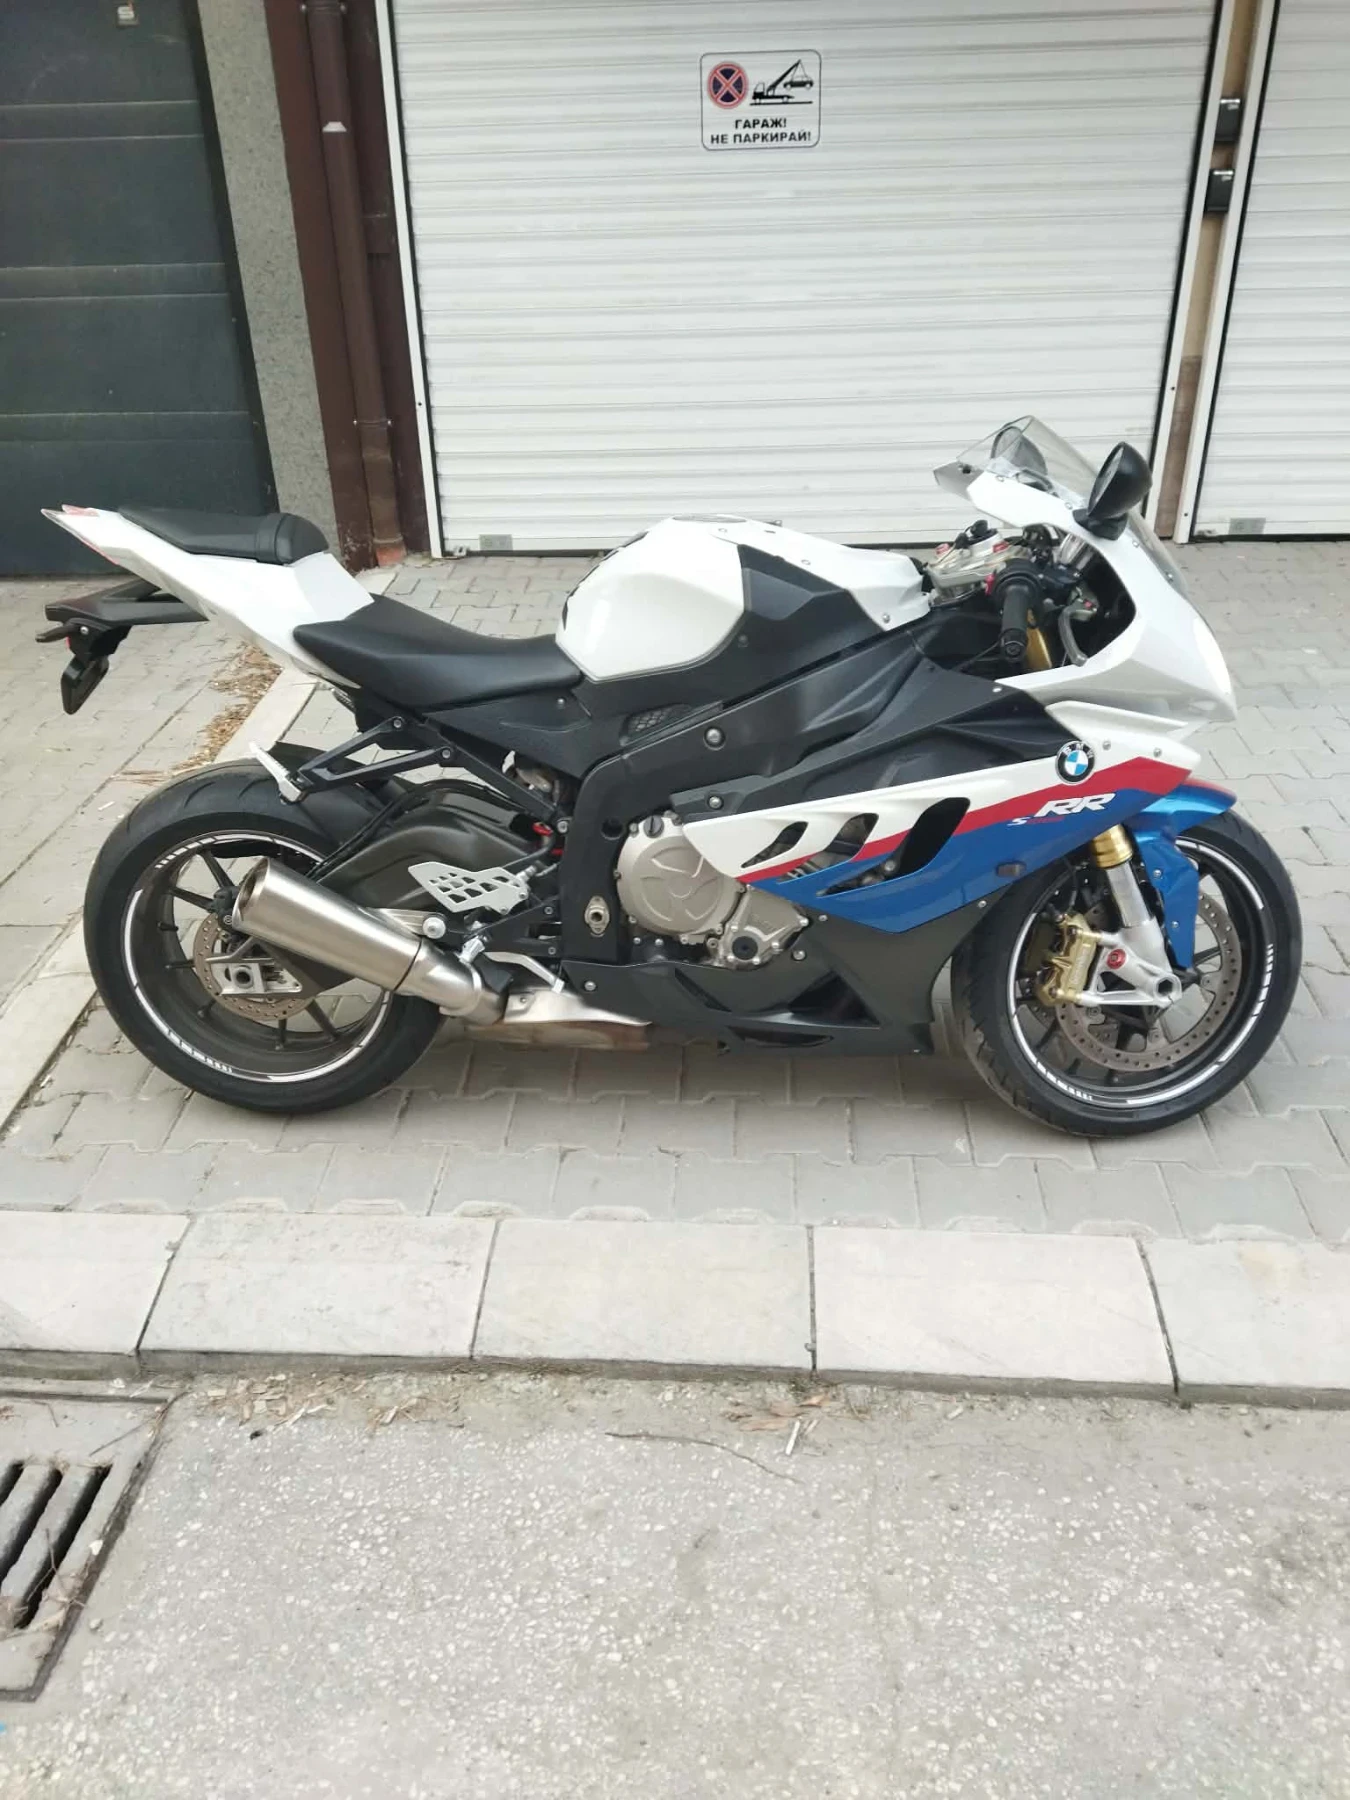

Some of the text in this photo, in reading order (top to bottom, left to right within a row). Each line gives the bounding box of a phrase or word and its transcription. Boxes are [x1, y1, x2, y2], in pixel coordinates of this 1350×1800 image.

[734, 118, 787, 129] ГАРАЖ!
[710, 130, 811, 144] НЕ ПАРКИРАЙ!
[1033, 792, 1116, 817] RR
